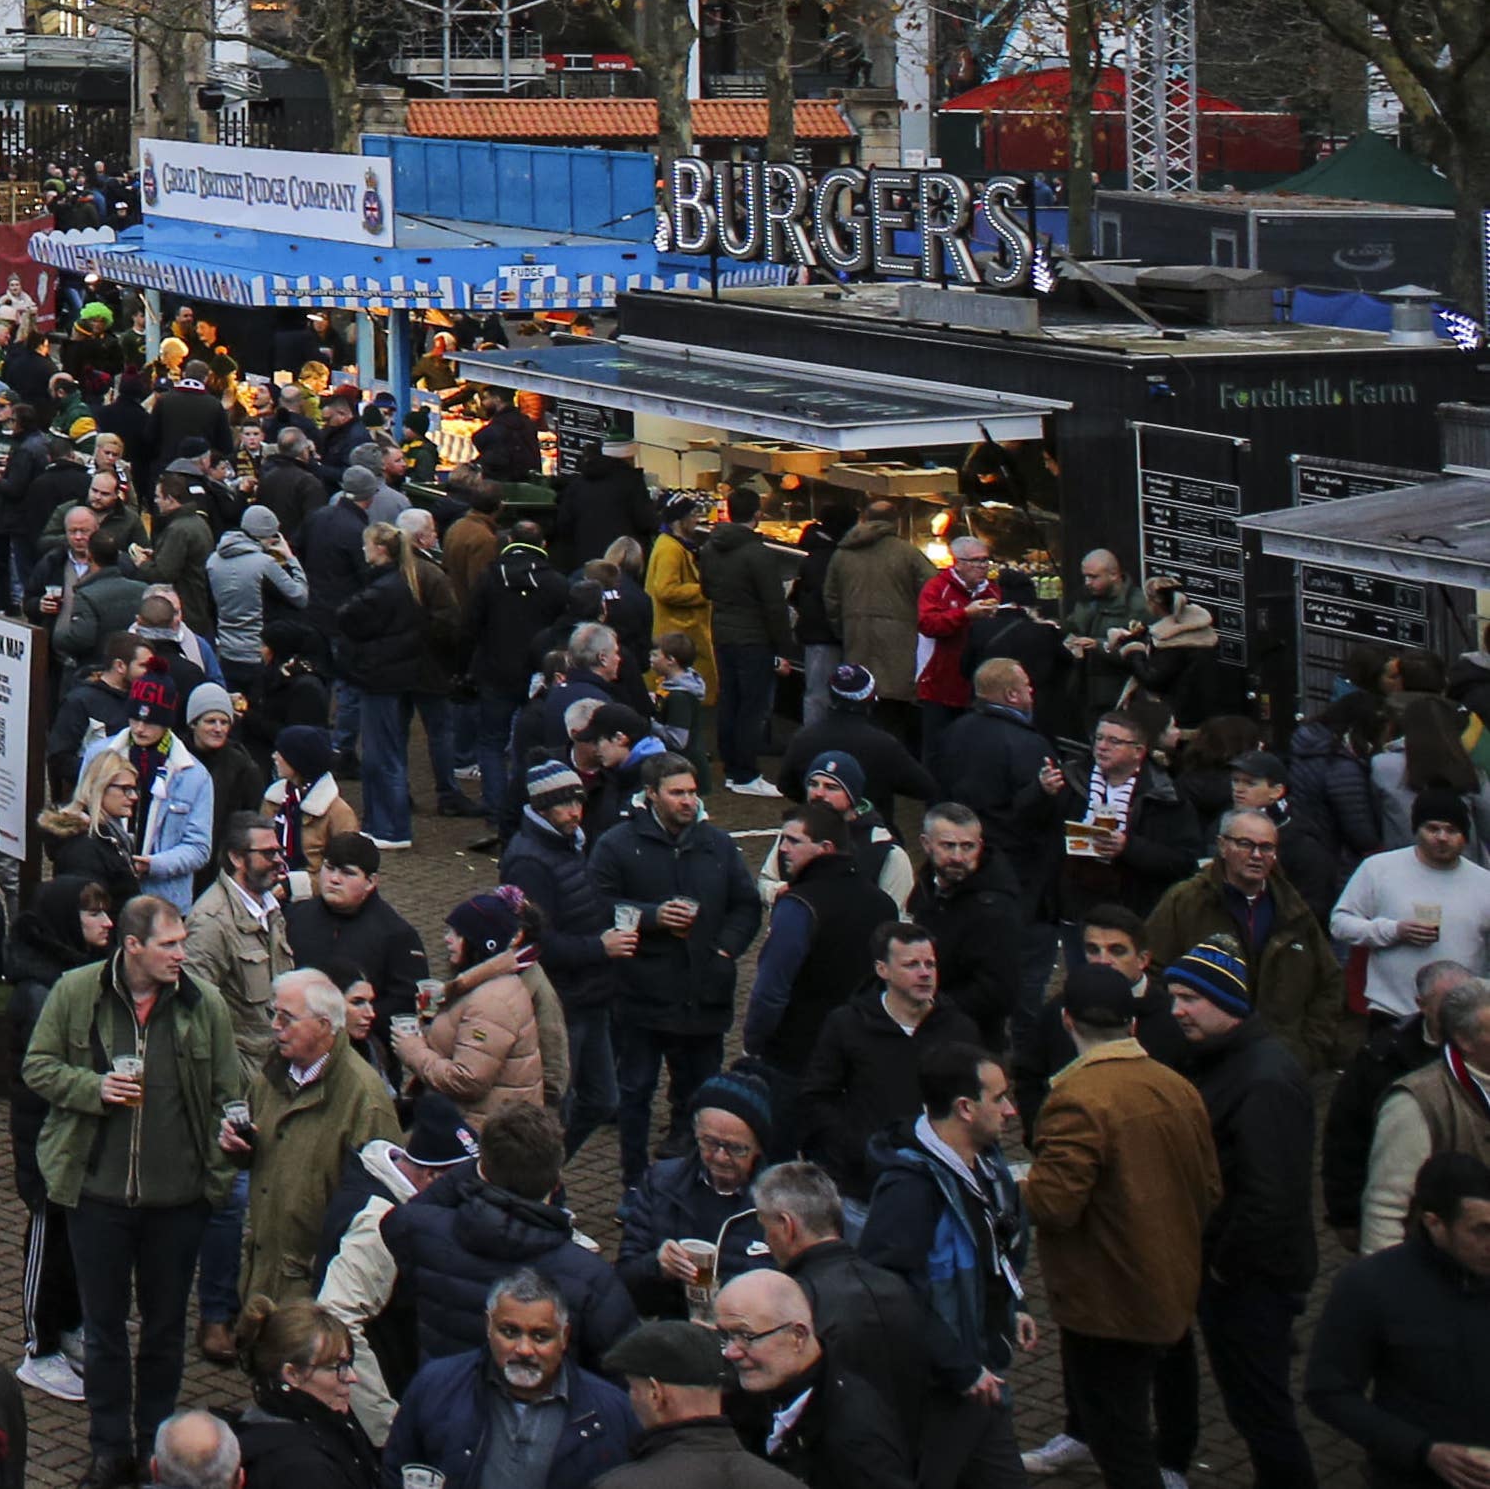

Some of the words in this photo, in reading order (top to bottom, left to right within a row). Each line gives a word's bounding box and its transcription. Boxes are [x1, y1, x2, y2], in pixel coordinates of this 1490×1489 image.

[162, 163, 197, 194] GREAT
[197, 166, 245, 200] BRITISH
[245, 172, 288, 205] FUDGE
[289, 176, 357, 212] COMPANY
[670, 157, 1033, 288] BURGERS
[510, 266, 545, 278] FUDGE
[1219, 378, 1334, 409] Fordhall
[1349, 379, 1417, 406] Farm
[6, 637, 24, 661] MAP
